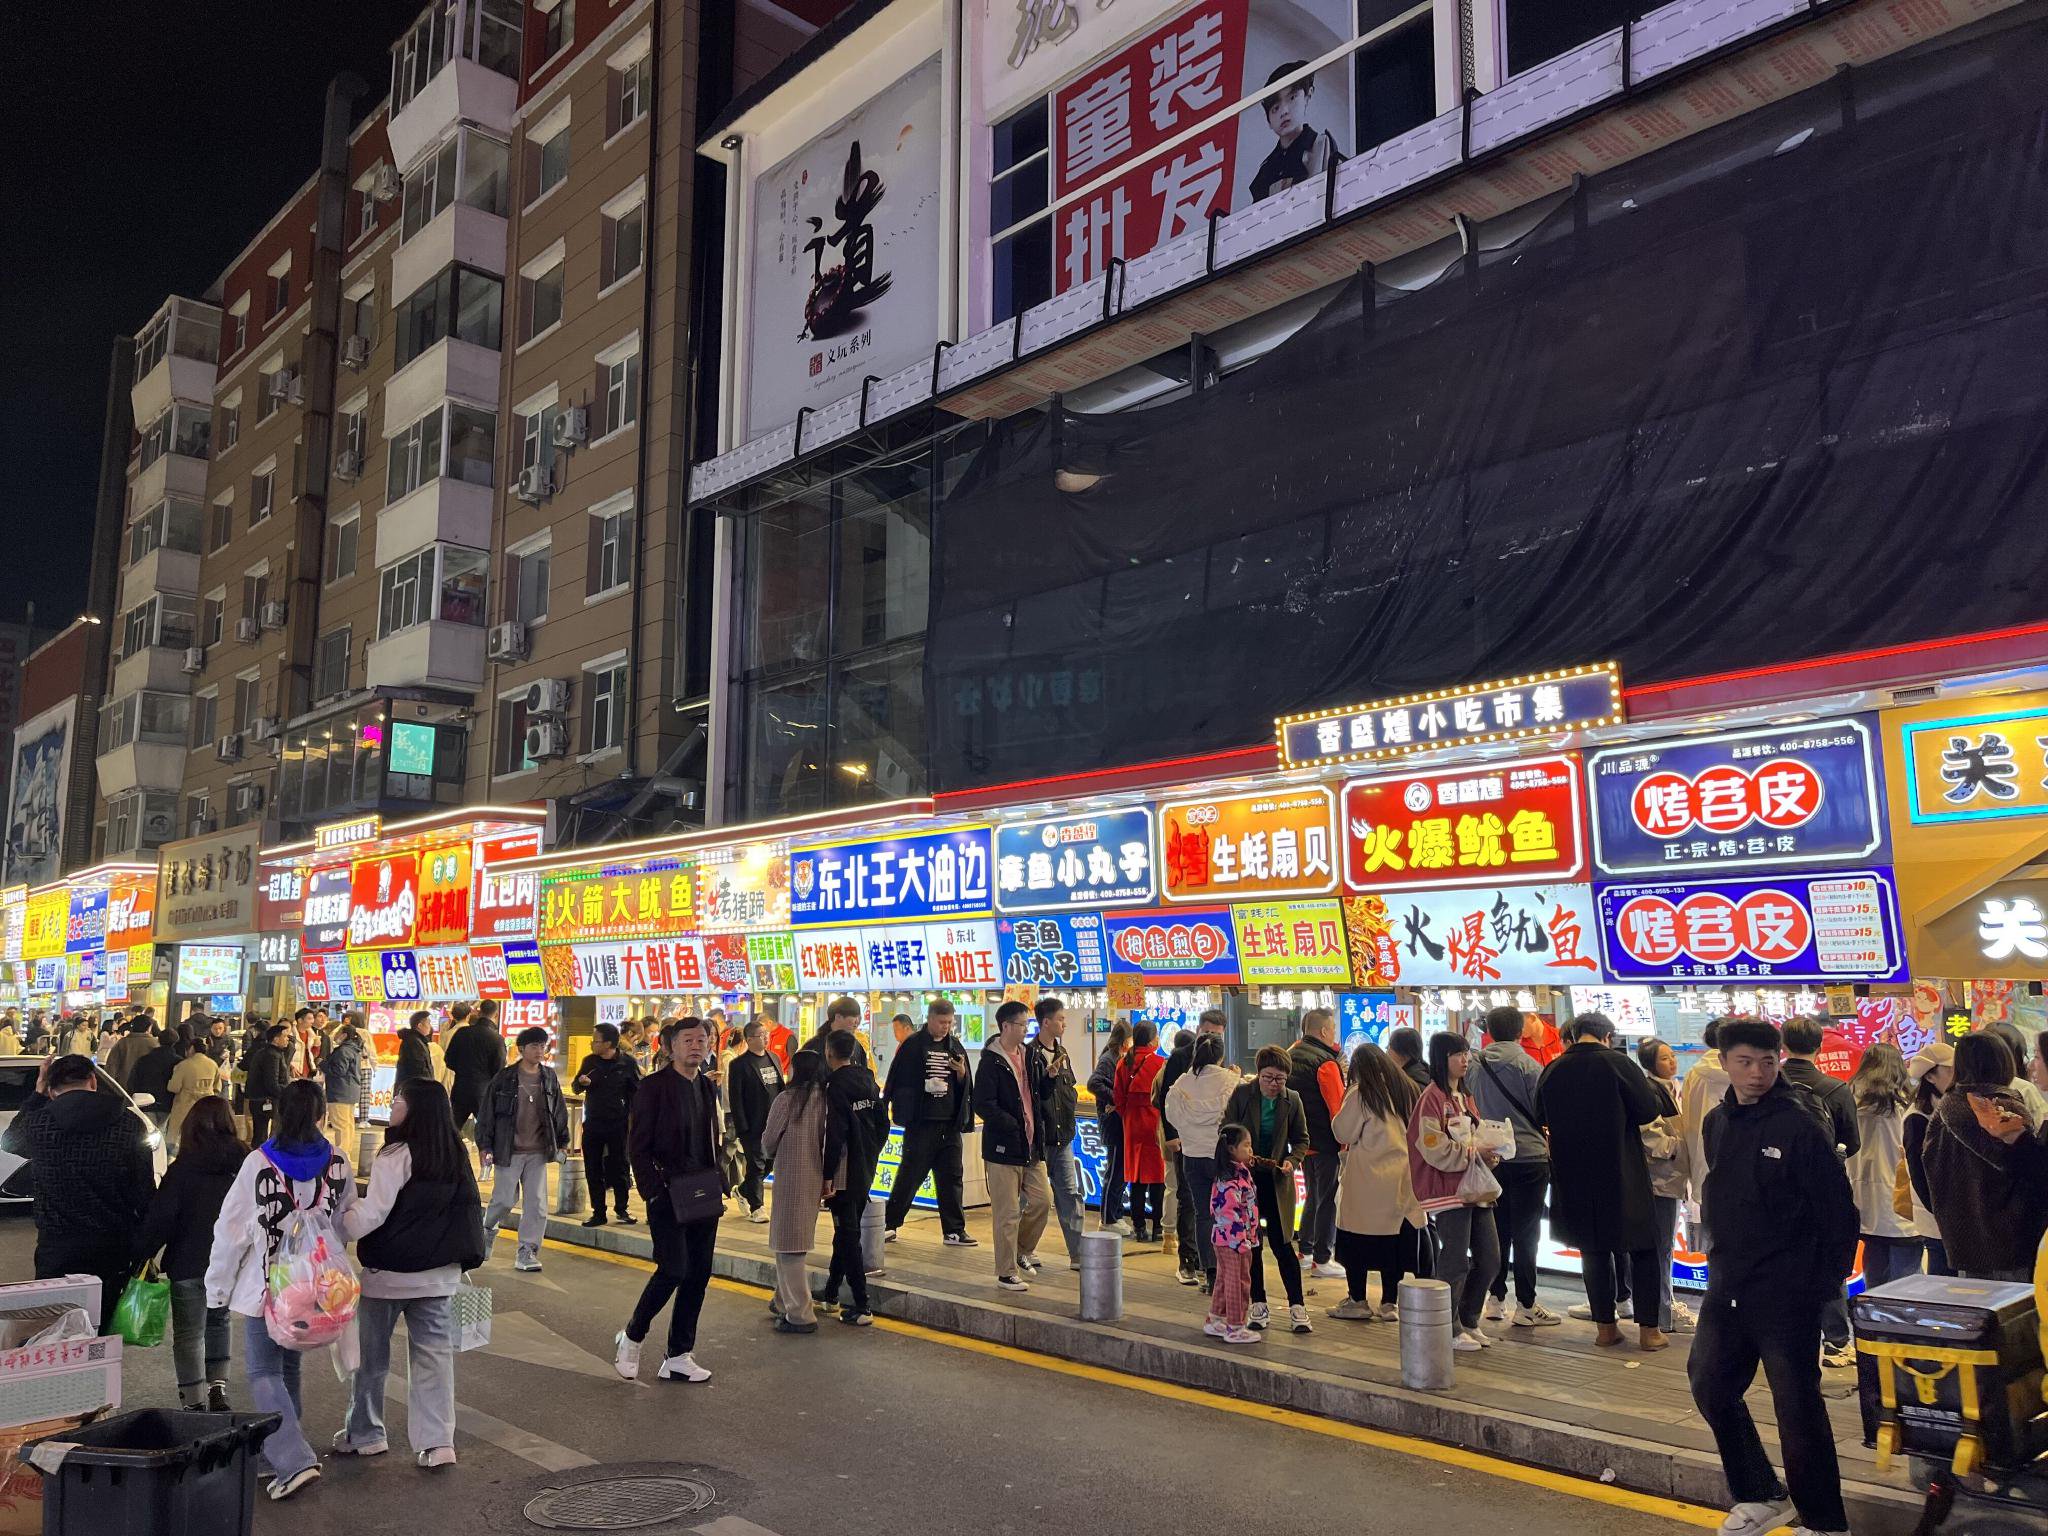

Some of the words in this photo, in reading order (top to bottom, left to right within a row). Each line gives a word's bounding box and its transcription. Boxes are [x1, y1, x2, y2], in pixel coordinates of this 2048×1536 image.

[1065, 11, 1223, 183] 童装
[1065, 143, 1225, 297] 批发
[826, 328, 872, 367] 文玩系列
[1316, 686, 1564, 753] 香盛煌小吃市集
[1600, 757, 1650, 775] 川品源
[1643, 771, 1809, 829] 烤苕皮
[1363, 809, 1560, 873] 火爆鱿鱼
[818, 840, 988, 911] 东北王大油边
[998, 841, 1150, 893] 章鱼小丸子
[555, 873, 694, 928] 火箭大鱿鱼
[956, 928, 976, 943] 东北
[1013, 919, 1063, 952] 章鱼
[1125, 931, 1214, 957] 拇指煎包
[1403, 889, 1598, 983] 火爆鱿鱼
[1628, 903, 1800, 955] 烤苕皮
[584, 943, 704, 991] 火爆大鱿鱼
[800, 941, 861, 979] 红柳烤肉
[868, 939, 926, 979] 烤羊腰子
[935, 949, 997, 985] 油边王
[1007, 951, 1079, 984] 小丸子
[1945, 1014, 1971, 1037] 老
